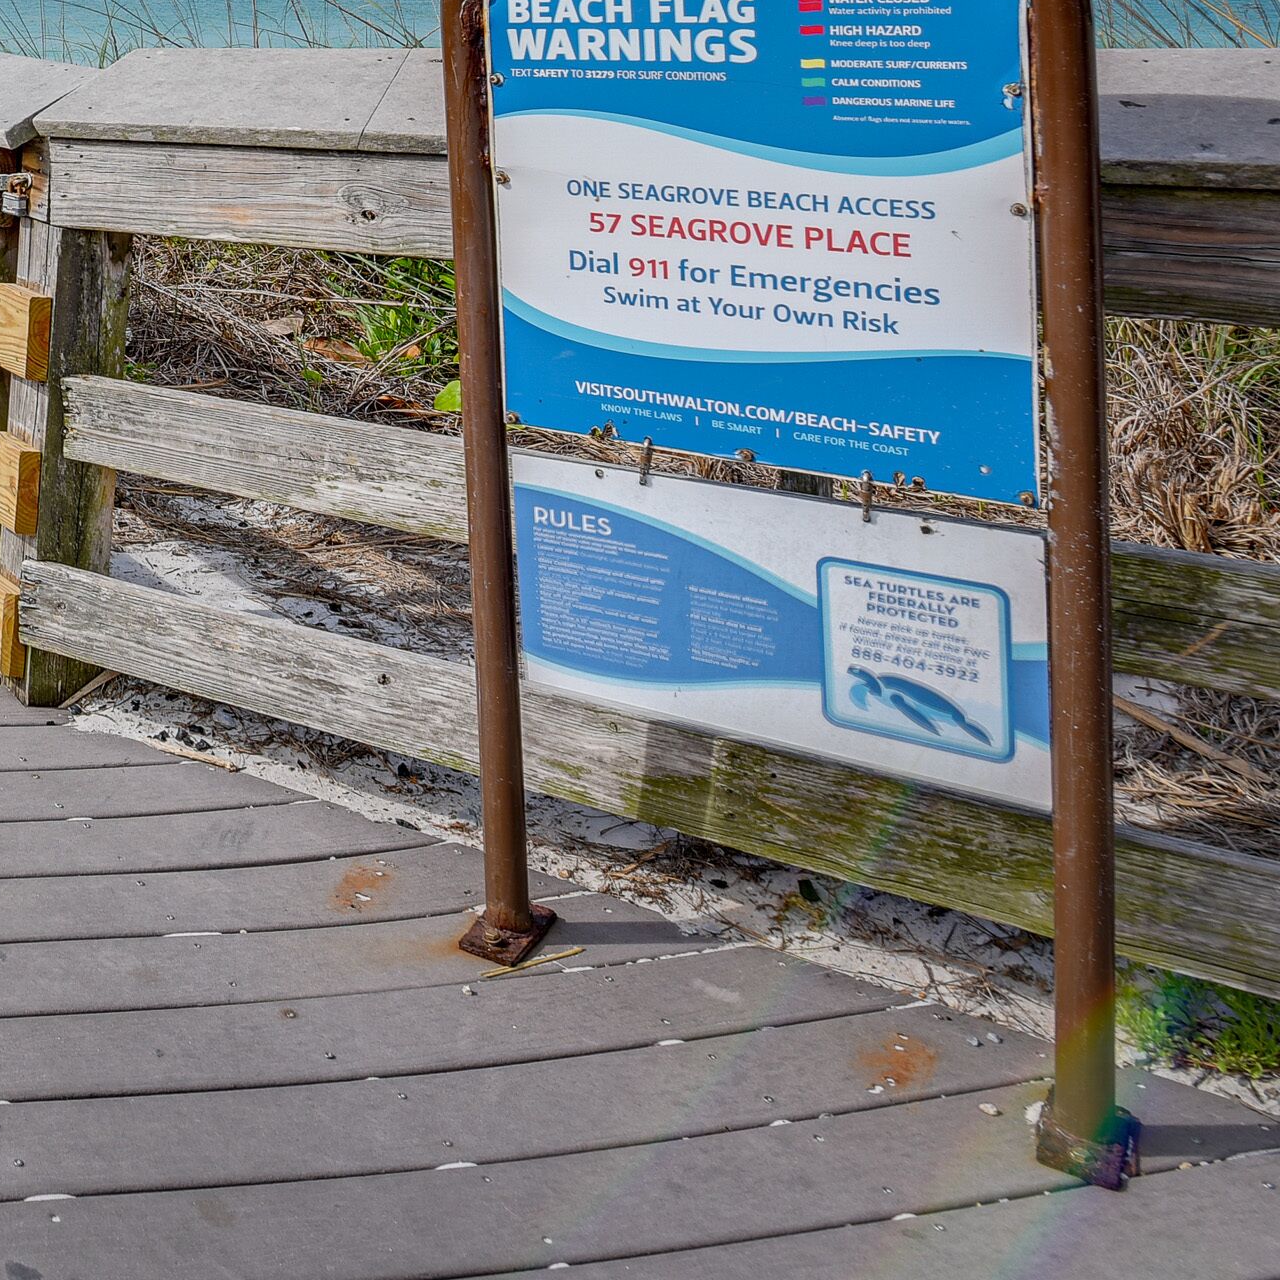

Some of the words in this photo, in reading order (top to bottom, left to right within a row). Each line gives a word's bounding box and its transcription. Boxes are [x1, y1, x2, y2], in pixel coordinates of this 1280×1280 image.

[828, 7, 855, 15] Water
[856, 6, 891, 16] activity
[893, 6, 901, 15] is
[902, 6, 952, 16] prohibited
[506, 28, 758, 64] WARNINGS
[829, 25, 862, 36] HIGH
[866, 25, 922, 36] HAZARD
[829, 39, 853, 47] Knee
[855, 39, 878, 49] deep
[879, 39, 887, 47] is
[907, 40, 930, 49] deep
[511, 68, 531, 78] TEXT
[533, 68, 569, 78] SAFETY
[571, 69, 583, 78] TO
[585, 70, 614, 79] 31279
[617, 70, 636, 79] FOR
[638, 70, 663, 80] SURF
[665, 71, 726, 81] CONDITIONS
[830, 60, 884, 69] MODERATE
[885, 60, 968, 70] SURF/CURRENTS
[831, 78, 859, 87] CALM
[860, 78, 921, 88] CONDITIONS
[832, 97, 892, 106] DANGEROUS
[894, 97, 932, 107] MARINE
[934, 99, 955, 108] LIFE
[567, 179, 611, 198] ONE
[618, 182, 740, 207] SEAGROVE
[747, 190, 829, 213] BEACH
[837, 196, 936, 220] ACCESS
[590, 212, 622, 234] 57
[630, 214, 794, 249] SEAGROVE
[804, 226, 912, 258] PLACE
[569, 249, 619, 275] Dial
[628, 257, 669, 280] 911
[678, 258, 720, 284] for
[730, 264, 941, 306] Emergencies
[603, 286, 669, 310] Swim
[676, 296, 701, 313] at
[708, 296, 765, 320] Your
[773, 303, 834, 328] Own
[842, 310, 900, 335] Risk
[575, 380, 941, 445] VISITSOUTHWALTON.COM/BEACH-SAFETY
[601, 403, 632, 415] KNOW
[633, 408, 652, 418] THE
[654, 410, 682, 422] LAWS
[711, 419, 725, 429] BE
[727, 421, 763, 435] SMART
[793, 431, 822, 443] CARE
[823, 435, 846, 447] FOR
[848, 439, 870, 451] THE
[872, 443, 910, 457] COAST
[533, 505, 612, 536] RULES
[844, 575, 873, 589] SEA
[877, 580, 945, 602] TURTLES
[949, 594, 981, 609] ARE
[868, 591, 956, 616] FEDERALLY
[866, 603, 959, 628] PROTECTED
[851, 645, 979, 683] 888-404-3922
